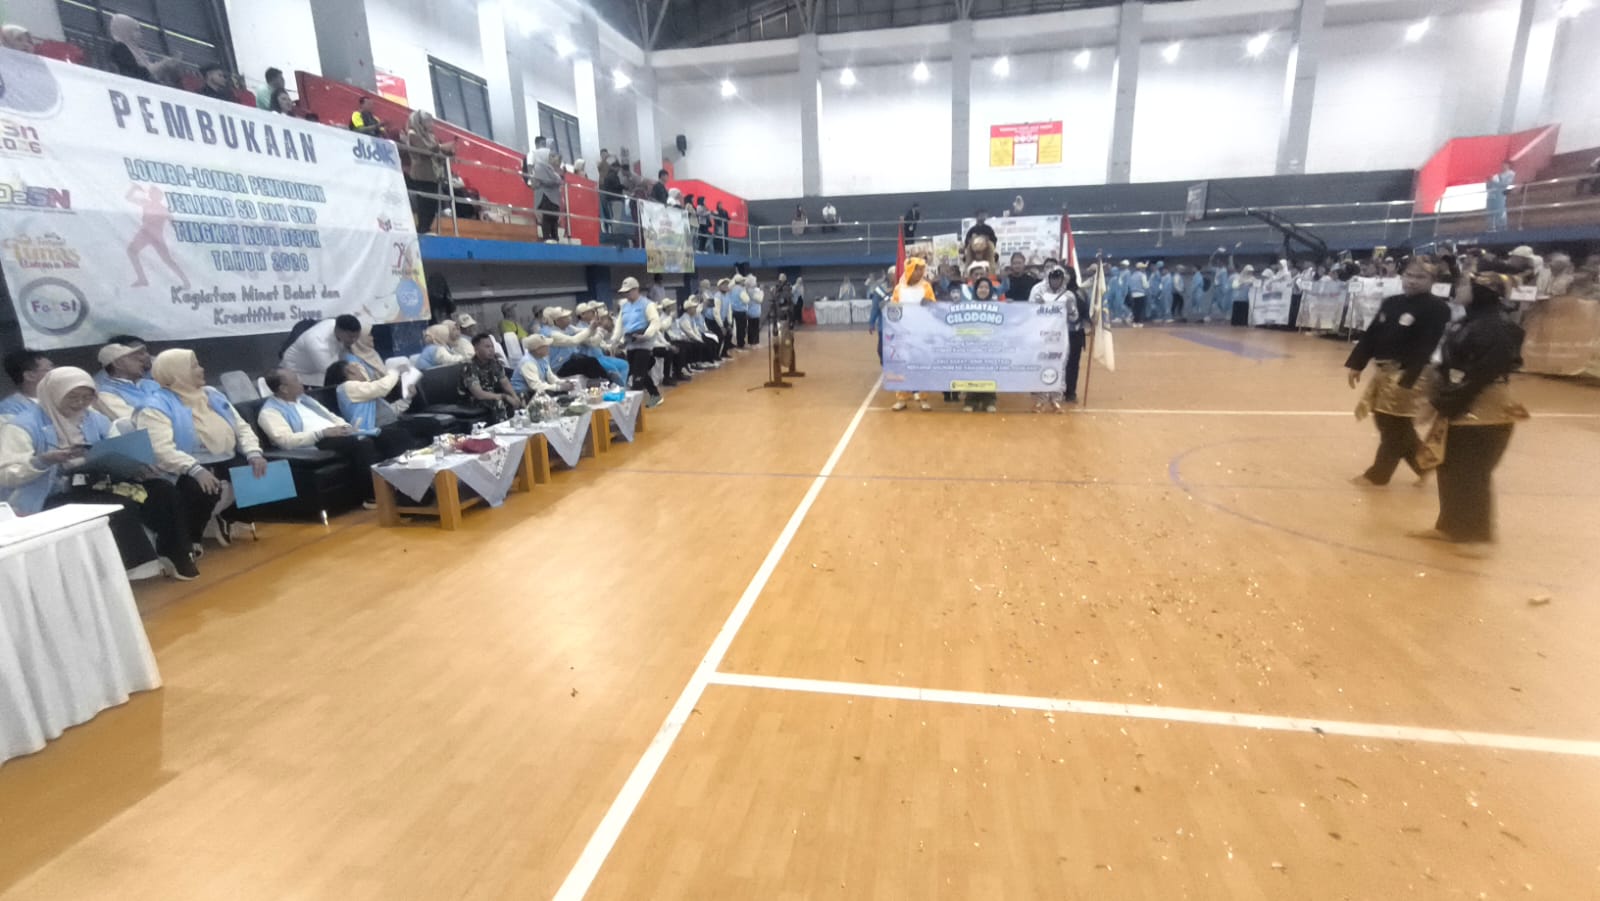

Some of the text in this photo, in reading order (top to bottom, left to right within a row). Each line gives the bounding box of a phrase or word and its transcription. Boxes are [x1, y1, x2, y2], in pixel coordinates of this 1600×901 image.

[108, 89, 318, 164] PEMBUKAAN
[123, 157, 327, 203] LOMBA-LOMBA PENDIDIKAN
[164, 191, 317, 225] JENJANG SD DAN SMP
[171, 220, 322, 249] TINGKAT KOTA DEPOK
[211, 250, 310, 272] TAHUN 2026
[170, 285, 237, 310] Kegiatan
[321, 284, 340, 299] dan
[950, 303, 999, 313] KECAMATAN
[946, 311, 1003, 325] CILODONG
